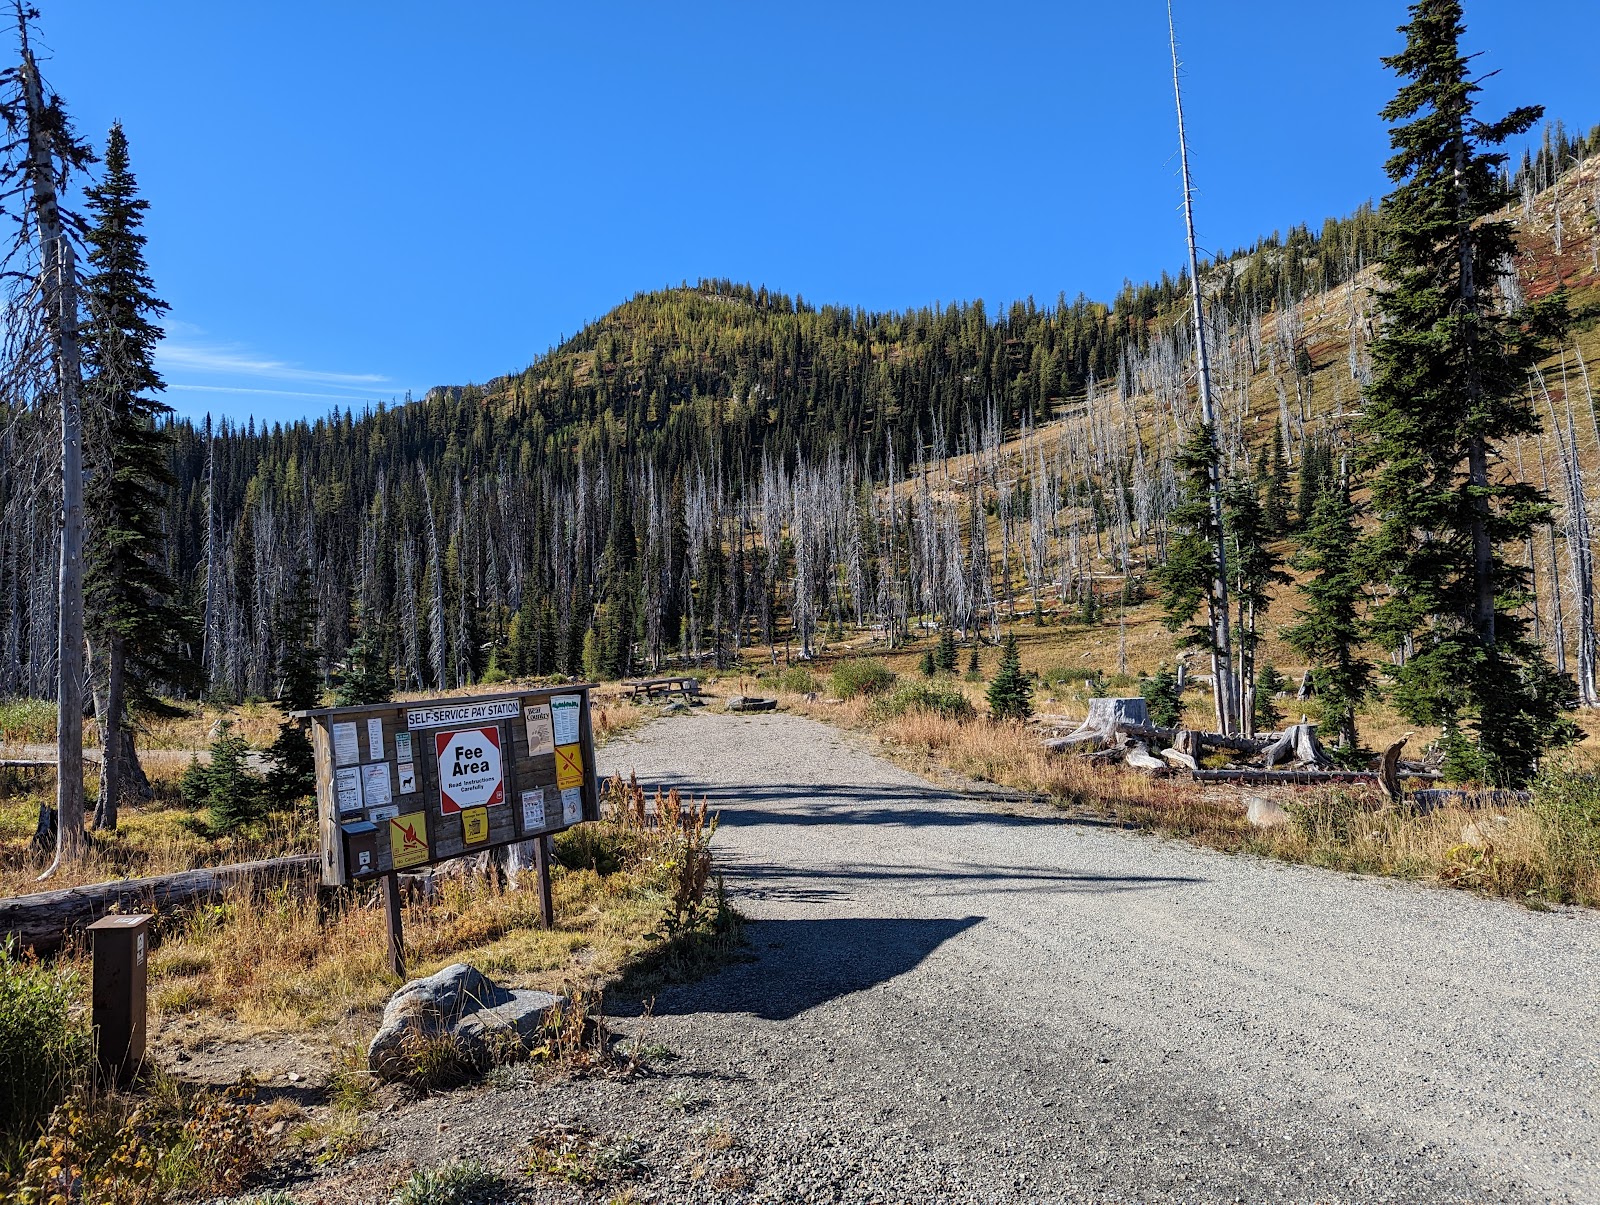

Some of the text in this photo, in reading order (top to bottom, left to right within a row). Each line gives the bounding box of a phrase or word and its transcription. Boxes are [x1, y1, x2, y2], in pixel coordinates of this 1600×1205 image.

[408, 702, 519, 725] SELF-SERVICE PAY STATION
[455, 746, 483, 761] Fee
[452, 761, 490, 777] Area
[463, 776, 495, 786] Instructions
[405, 854, 426, 862] Campfires
